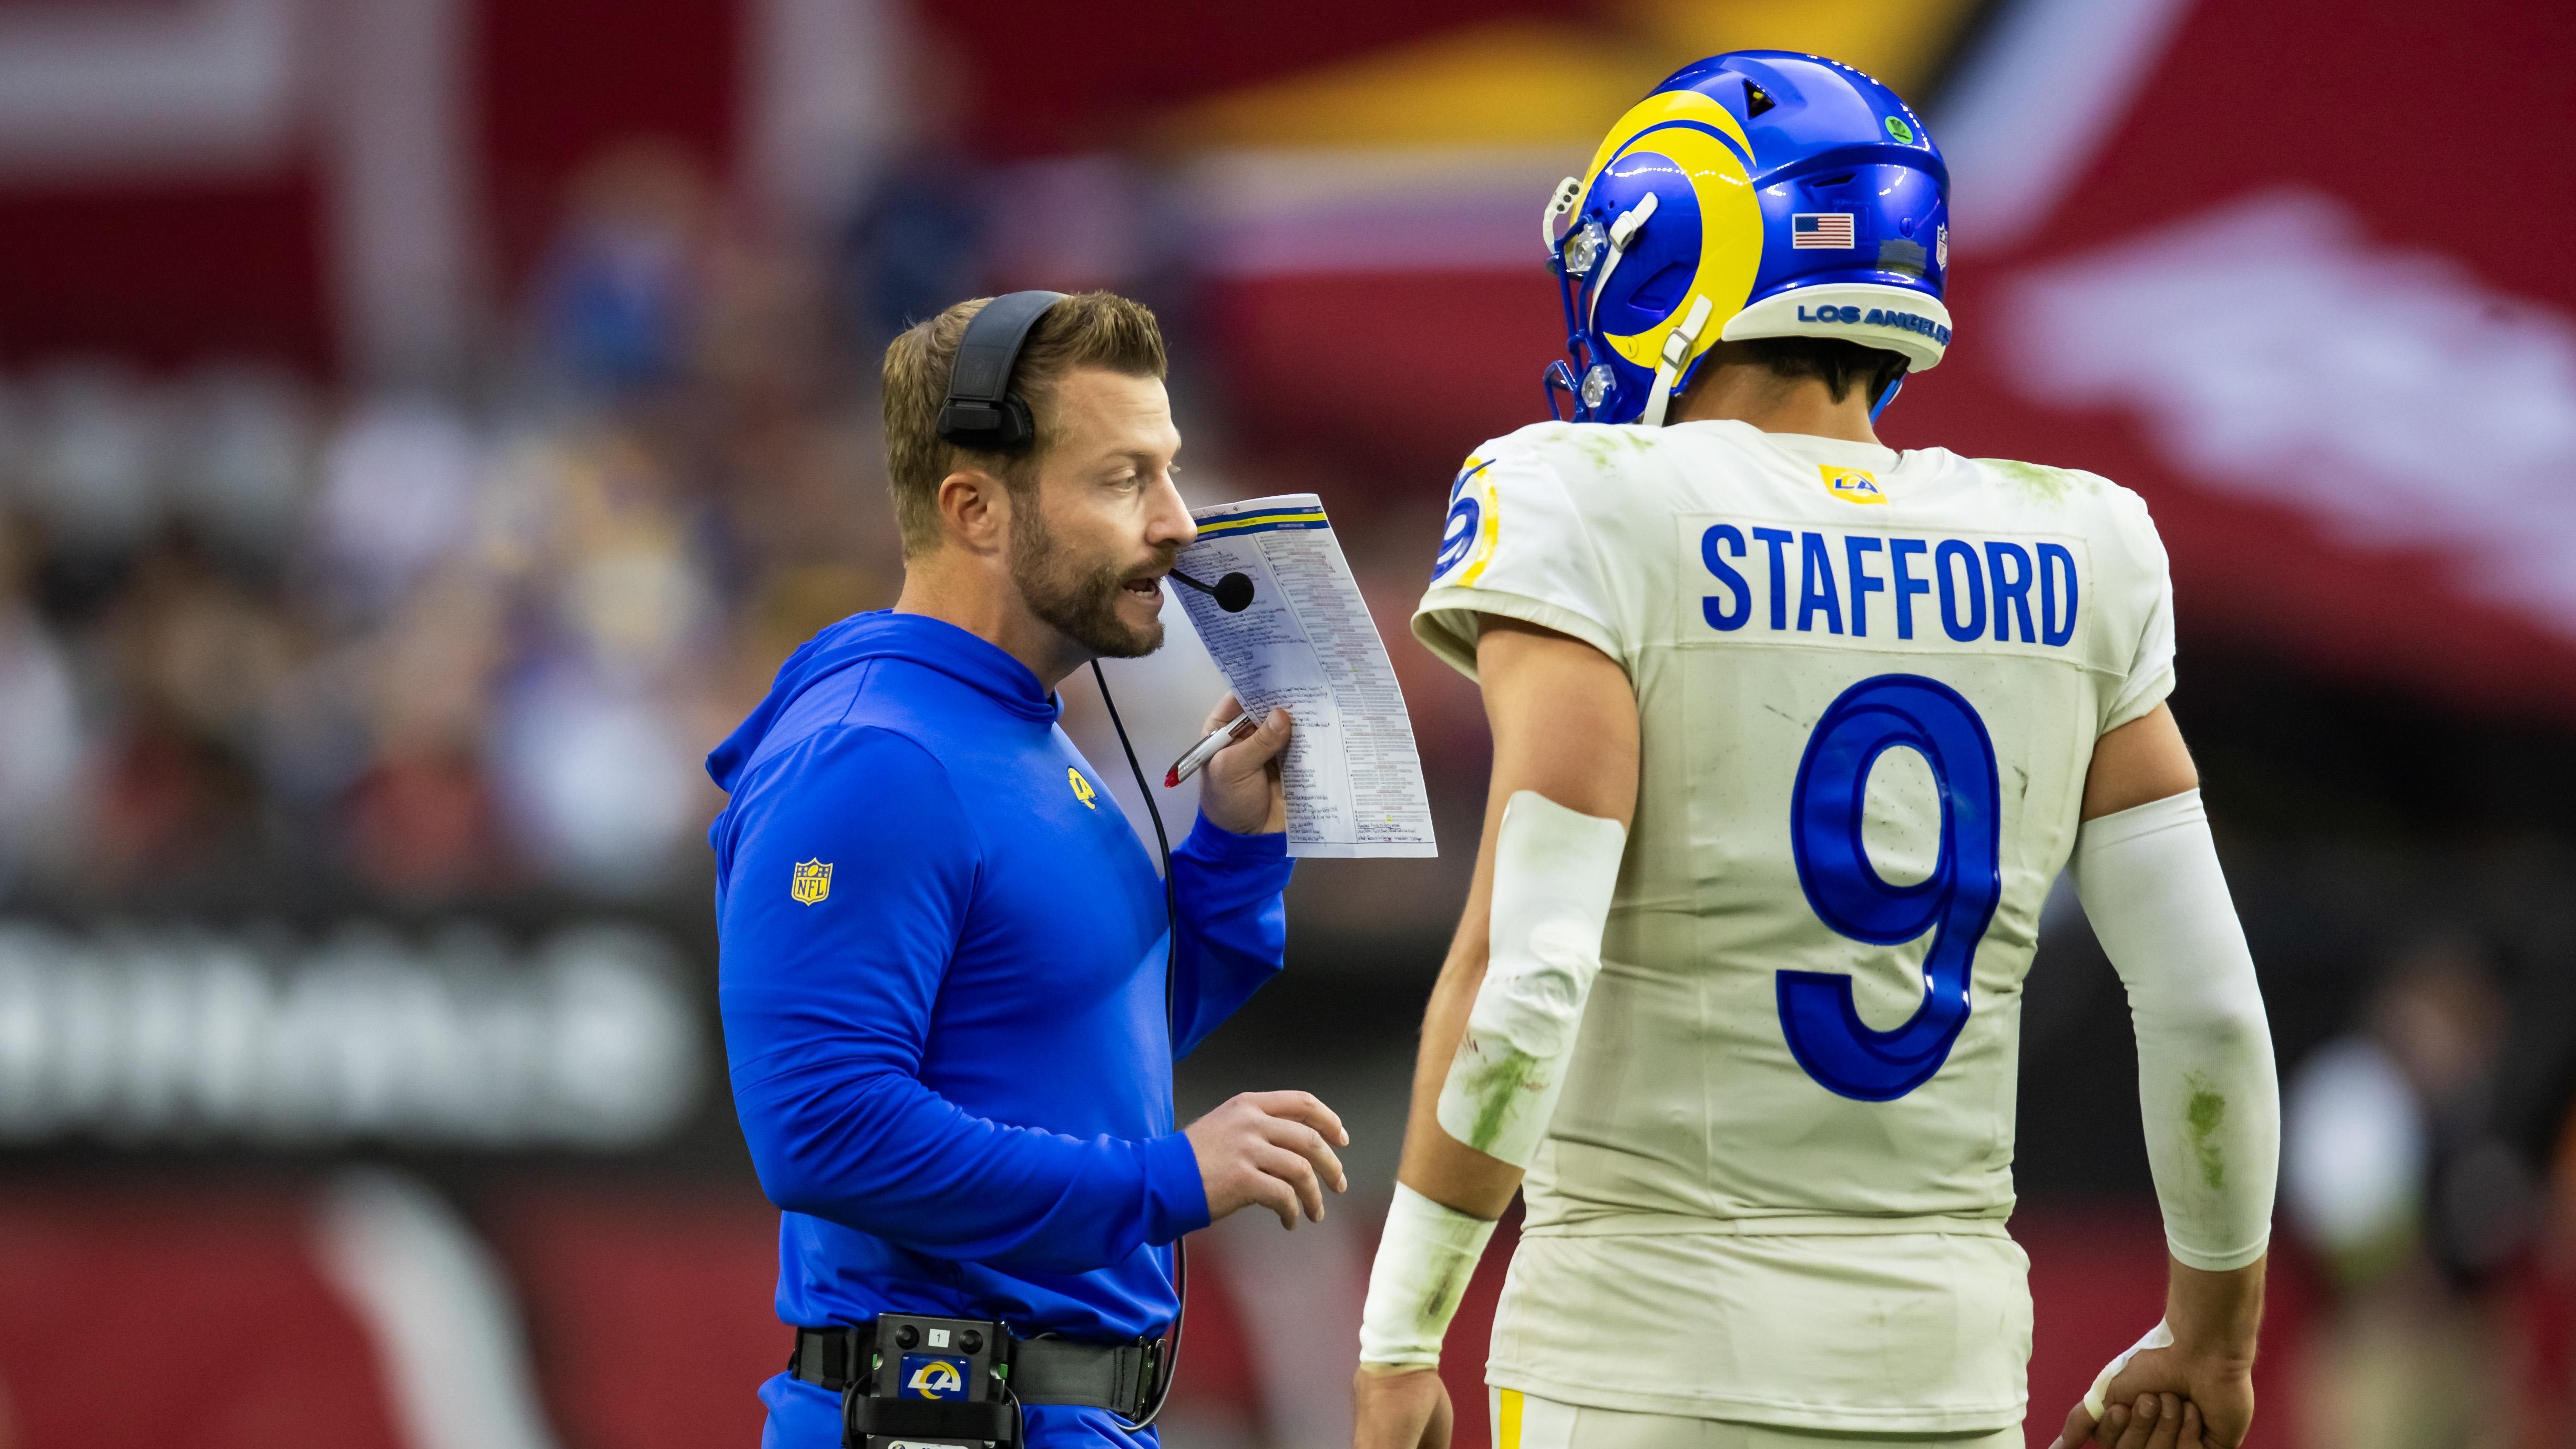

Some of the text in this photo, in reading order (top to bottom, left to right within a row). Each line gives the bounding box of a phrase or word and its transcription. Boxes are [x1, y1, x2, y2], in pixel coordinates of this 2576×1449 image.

[1798, 304, 1861, 324] LOS
[1430, 497, 1480, 583] 9
[1701, 523, 2079, 647] STAFFORD
[796, 879, 824, 898] NFL
[1776, 672, 2001, 1103] 9
[936, 1333, 941, 1342] 1
[907, 1361, 962, 1393] LA
